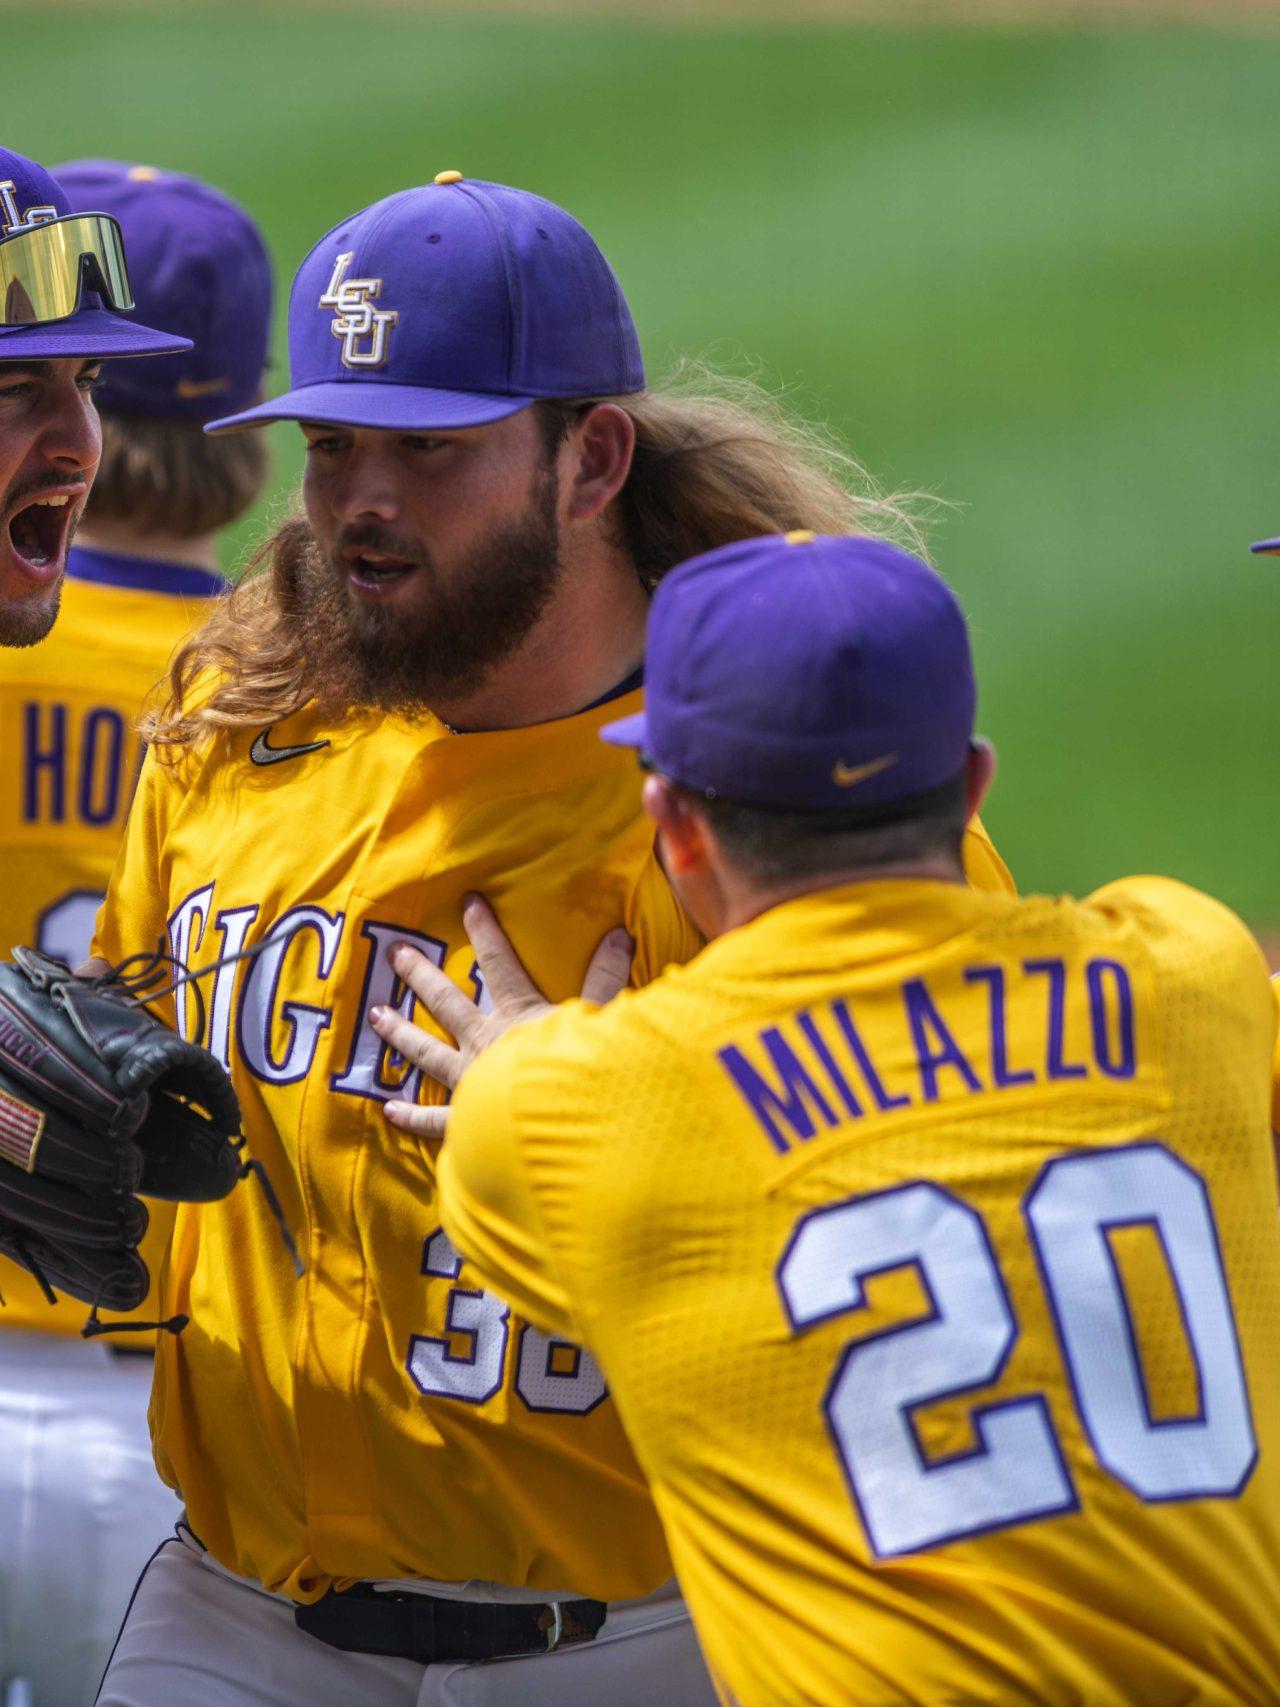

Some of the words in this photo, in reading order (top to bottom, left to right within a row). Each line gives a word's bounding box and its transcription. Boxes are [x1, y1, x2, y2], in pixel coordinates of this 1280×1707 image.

[319, 251, 398, 369] LSU
[22, 702, 144, 828] HO
[718, 958, 1136, 1154] MILAZZO
[775, 1140, 1259, 1558] 20
